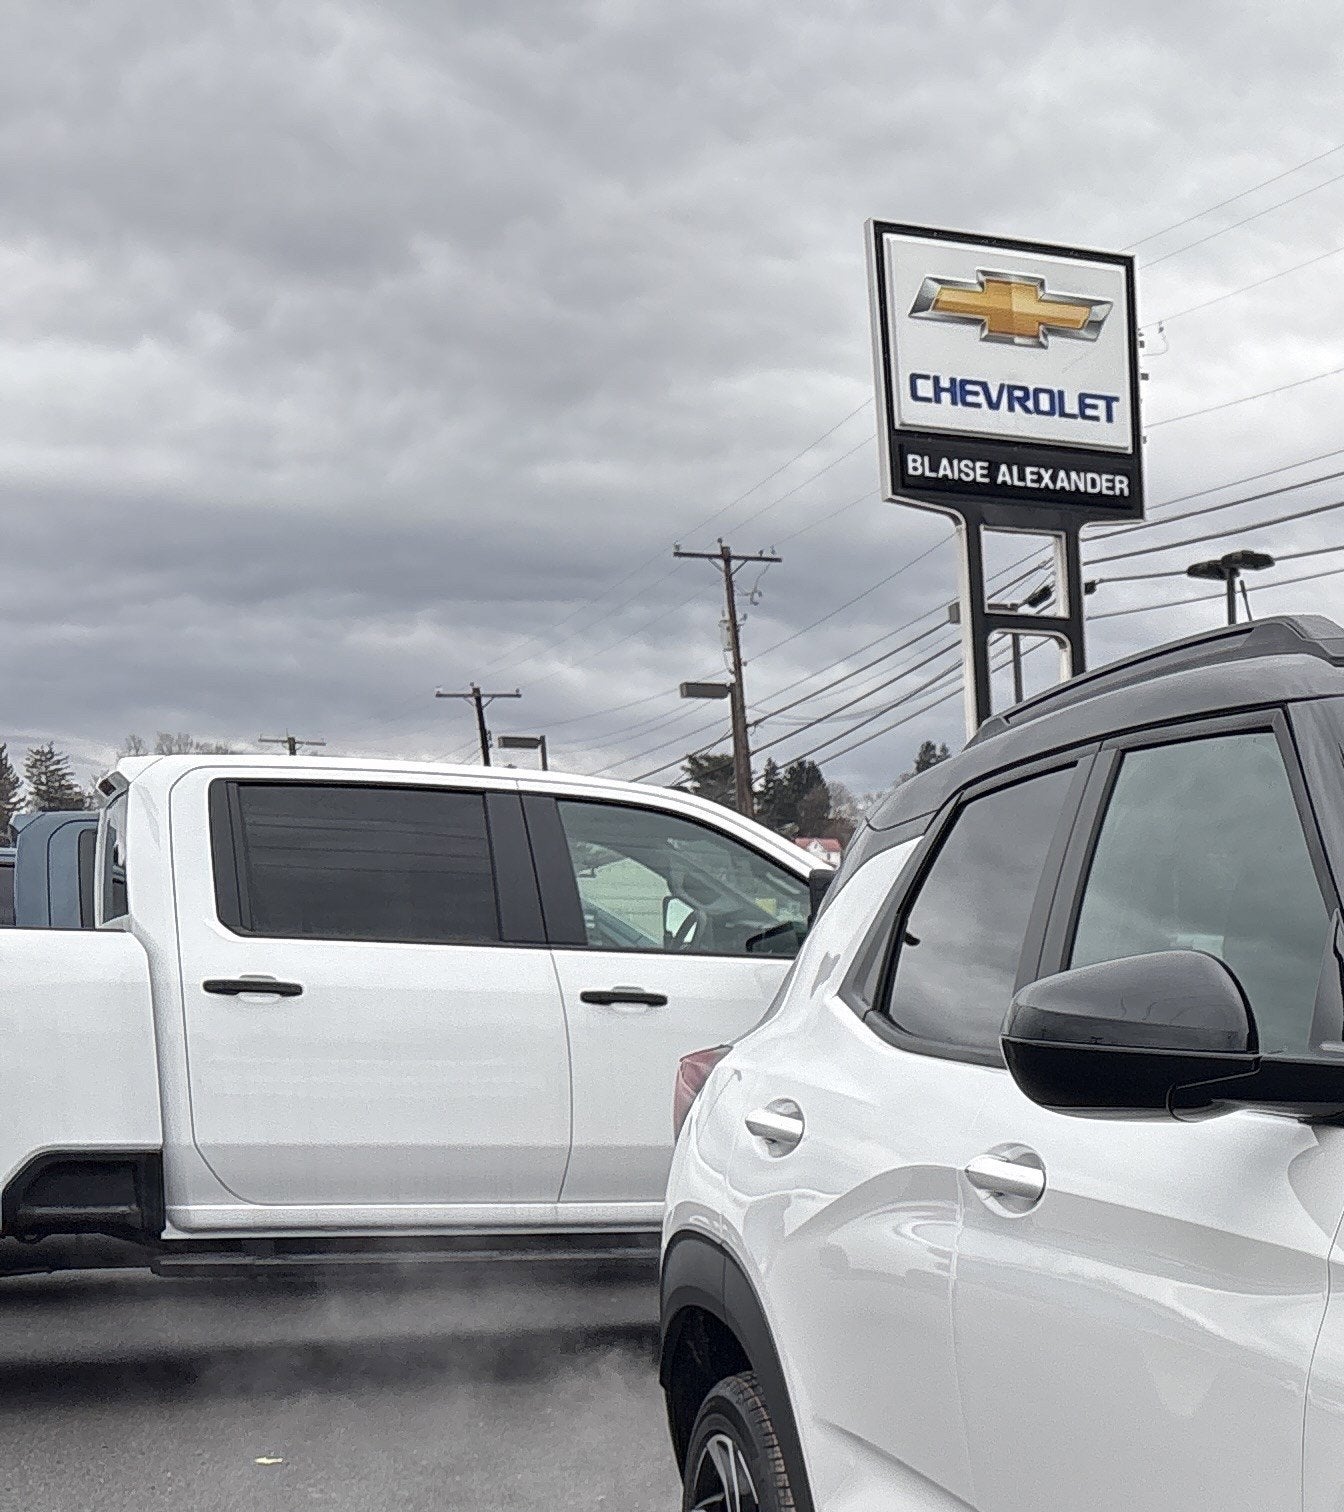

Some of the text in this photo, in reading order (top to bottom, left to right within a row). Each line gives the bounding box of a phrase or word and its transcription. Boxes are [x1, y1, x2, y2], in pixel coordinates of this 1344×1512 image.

[909, 372, 1120, 423] CHEVROLET
[907, 453, 1129, 497] BLAISE ALEXANDER
